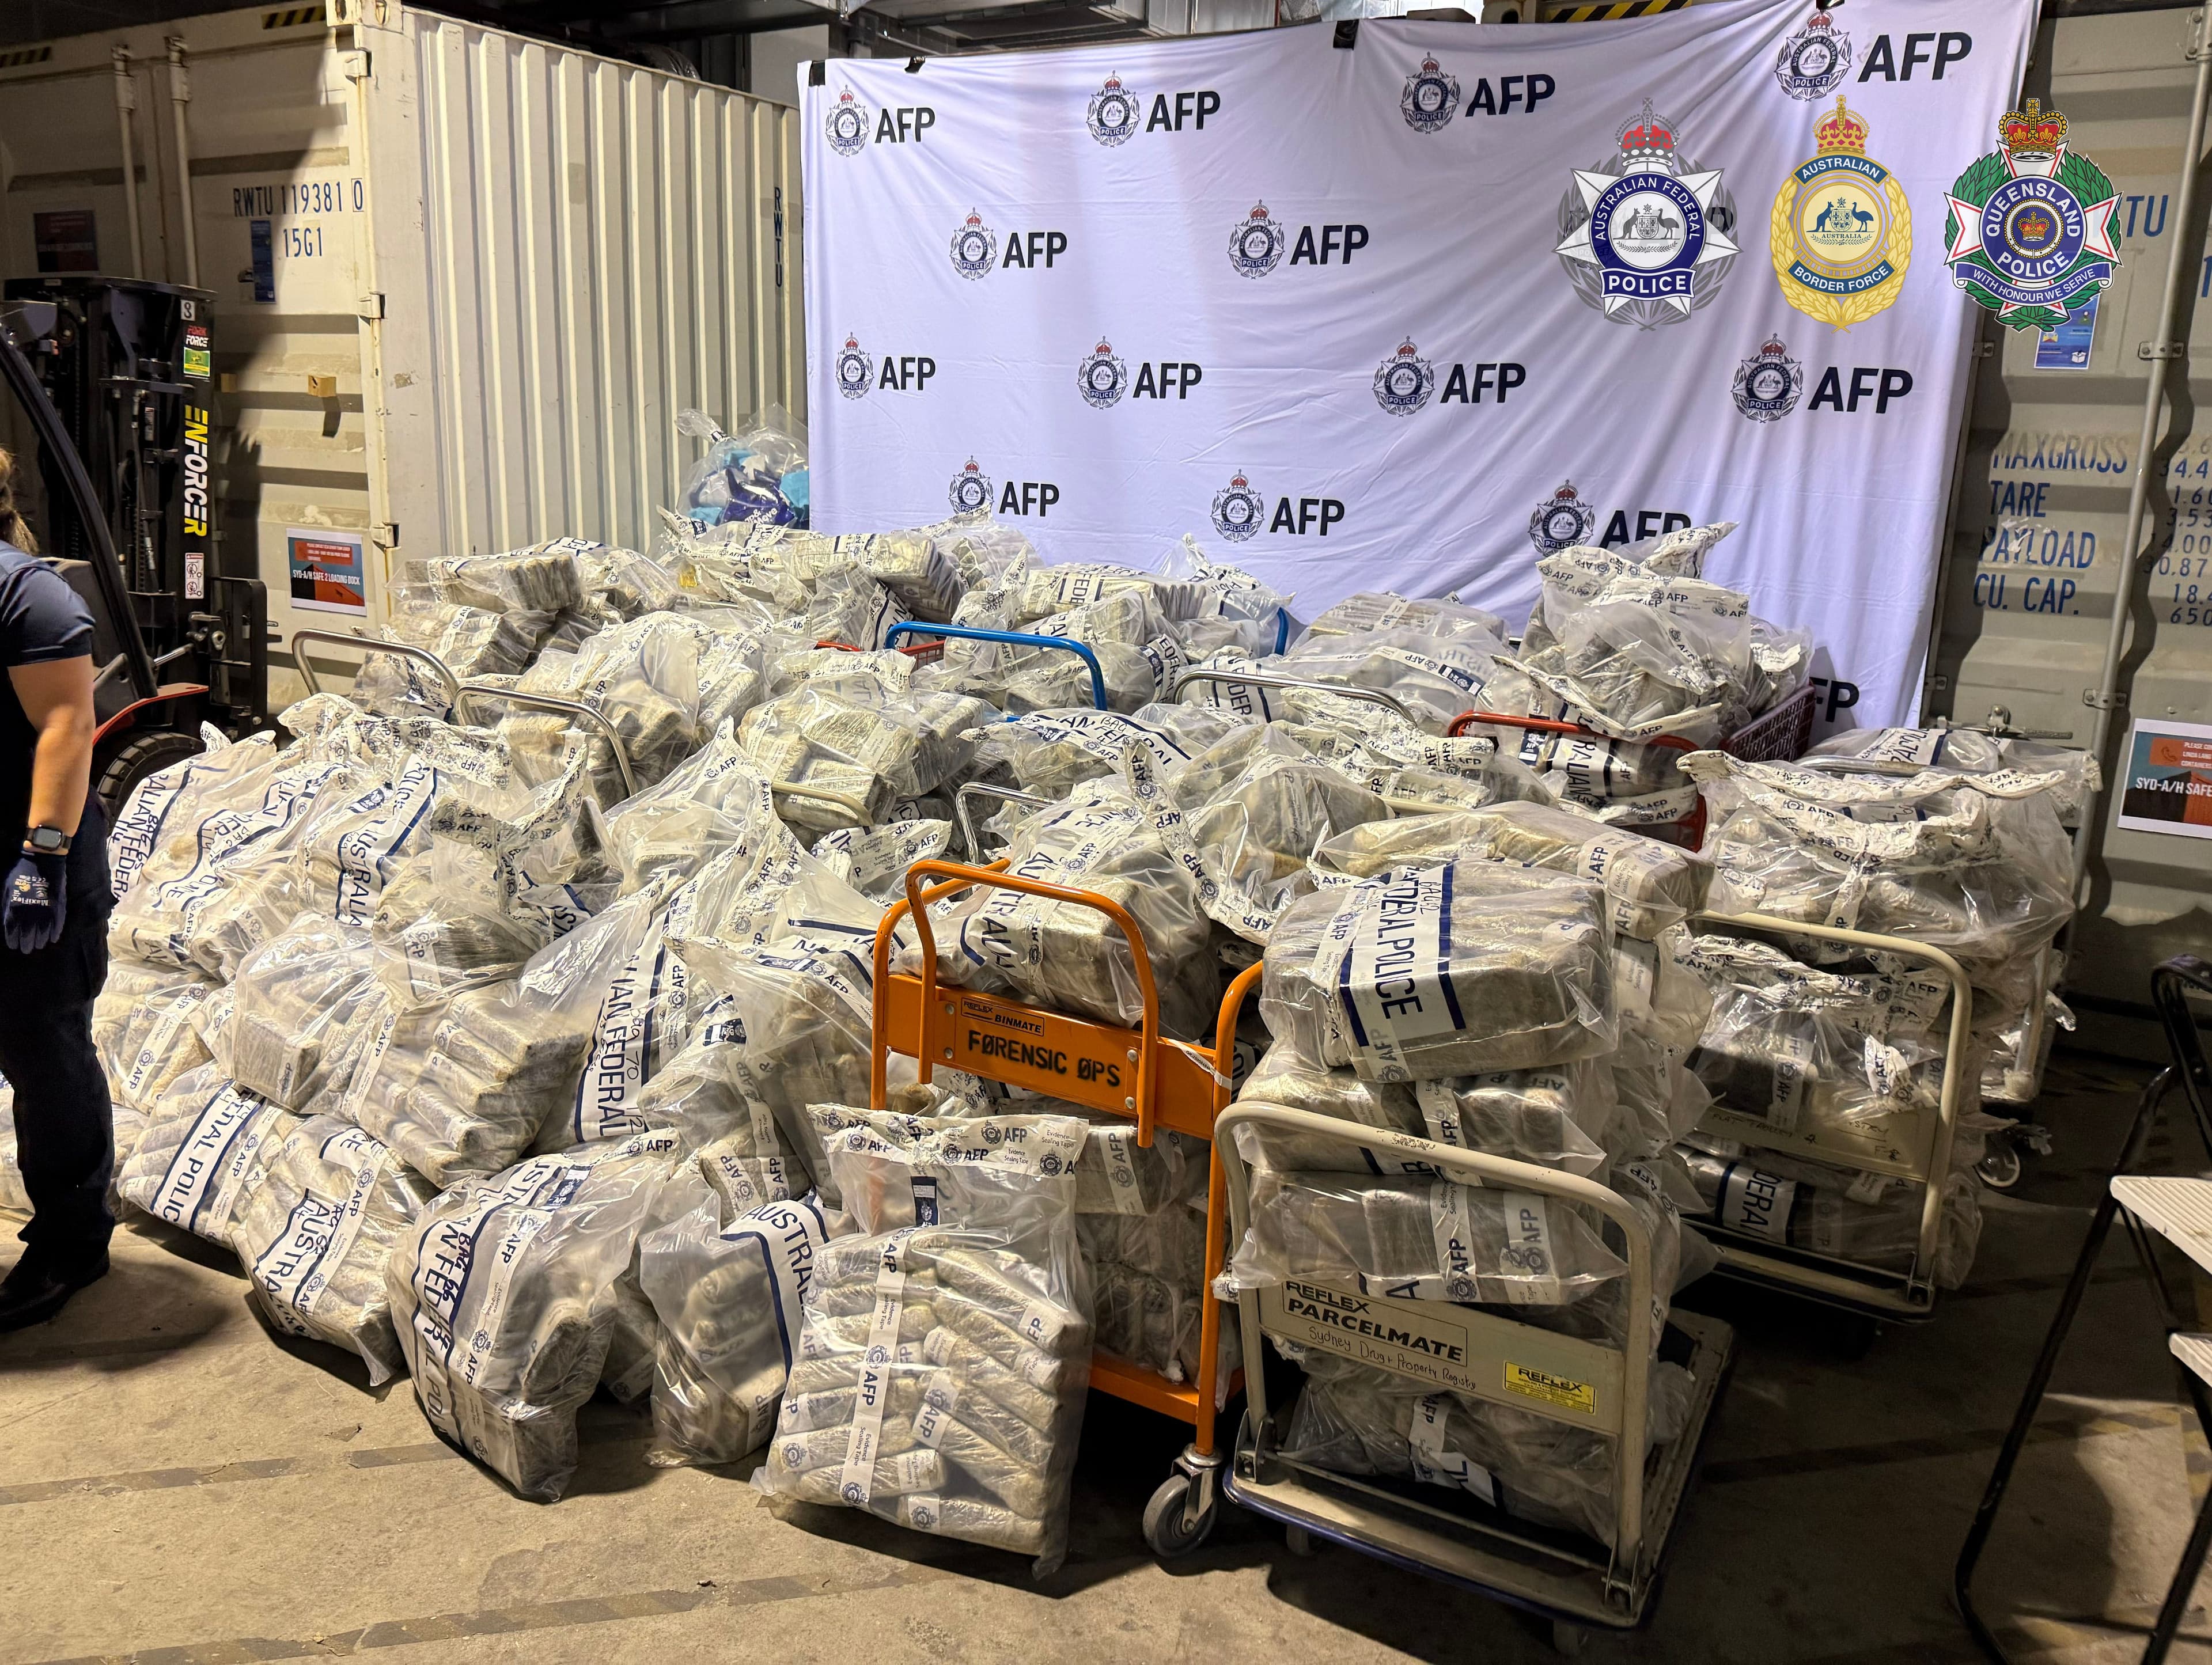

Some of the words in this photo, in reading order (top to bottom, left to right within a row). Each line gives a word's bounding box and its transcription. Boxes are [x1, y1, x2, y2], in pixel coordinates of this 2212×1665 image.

[1793, 37, 1820, 66] AUSTRALIAN
[1857, 32, 1972, 83] AFP
[1796, 78, 1827, 86] POLICE
[1465, 74, 1555, 117] AFP
[1146, 90, 1221, 132] AFP
[875, 107, 935, 143] AFP
[233, 186, 273, 217] RWTU
[281, 181, 342, 215] 119381
[353, 180, 363, 211] 0
[284, 227, 323, 257] 15G1
[774, 187, 783, 287] RWTU
[1289, 224, 1369, 266] AFP
[1002, 232, 1067, 268] AFP
[184, 302, 192, 319] 8
[185, 335, 209, 347] FORCE
[879, 356, 935, 390] AFP
[1132, 362, 1202, 400] AFP
[1385, 363, 1408, 386] AUSTRALIAN
[1440, 363, 1526, 403] AFP
[1747, 363, 1774, 388] AUSTRALIAN
[1775, 363, 1789, 390] FEDERAL
[1808, 366, 1913, 414] AFP
[1750, 401, 1781, 409] POLICE
[1994, 432, 2128, 474] MAXGROSS
[184, 404, 208, 537] ENFORCER
[999, 481, 1059, 517] AFP
[1222, 494, 1241, 515] AUSTRALIAN
[1990, 480, 2051, 518] TARE
[1270, 497, 1344, 536] AFP
[1982, 525, 2096, 569] PAYLOAD
[293, 569, 313, 580] SYD-A/H
[313, 571, 325, 582] SAFE
[325, 572, 329, 582] 2
[329, 574, 347, 584] LOADING
[347, 576, 361, 586] DOCK
[1552, 570, 1574, 581] AFP
[1615, 557, 1623, 576] AFP
[1666, 592, 1688, 602] AFP
[1974, 574, 2008, 610] CU.
[2024, 579, 2080, 615] CAP.
[1405, 655, 1426, 665] AFP
[699, 681, 711, 693] AFP
[1100, 717, 1128, 733] BAG
[1639, 726, 1663, 736] AFP
[719, 757, 737, 772] AFP
[1097, 749, 1118, 761] AFP
[1131, 754, 1147, 781] AFP
[2136, 777, 2184, 794] SYD-A/H
[2186, 783, 2212, 798] SAFE
[762, 791, 770, 811] AFP
[1156, 811, 1181, 829] AFP
[1656, 808, 1678, 821] AFP
[921, 833, 938, 848] AFP
[1079, 843, 1094, 859] AFP
[758, 857, 775, 883] AFP
[1184, 854, 1206, 879] AFP
[1588, 846, 1608, 876] AFP
[348, 830, 378, 927] USTRALIA
[1323, 876, 1352, 885] AFP
[1613, 863, 1628, 888] Evidence
[1243, 915, 1272, 930] AFP
[1615, 900, 1635, 931] AFP
[1330, 924, 1350, 940] AFP
[672, 965, 684, 988] AFP
[825, 974, 849, 993] AFP
[1374, 937, 1423, 1019] POLICE
[1907, 982, 1937, 997] AFP
[963, 1002, 994, 1014] REFLEX
[994, 1014, 1043, 1034] BINMATE
[376, 1031, 386, 1057] AFP
[130, 1066, 142, 1090] AFP
[599, 1025, 627, 1137] FEDERAL
[646, 1139, 673, 1153] AFP
[1004, 1127, 1028, 1144] AFP
[1041, 1137, 1059, 1146] Sealing
[1059, 1139, 1075, 1149] Tape
[1047, 1129, 1069, 1140] Evidence
[963, 1149, 989, 1161] AFP
[1005, 1155, 1018, 1163] Sealing
[1008, 1148, 1025, 1156] Evidence
[1109, 1132, 1127, 1163] AFP
[233, 1152, 247, 1177] AFP
[720, 1155, 744, 1179] AFP
[770, 1158, 784, 1184] AFP
[1629, 1167, 1658, 1192] AFP
[351, 1189, 363, 1217] AFP
[1521, 1207, 1541, 1244] AFP
[503, 1233, 522, 1264] AFP
[884, 1243, 897, 1274] AFP
[1450, 1238, 1469, 1276] AFP
[881, 1294, 891, 1315] Sealing
[1286, 1280, 1370, 1314] REFLEX
[879, 1315, 887, 1330] Tape
[887, 1298, 896, 1326] Evidence
[1287, 1299, 1464, 1363] PARCELMATE
[466, 1352, 478, 1386] AFP
[1308, 1326, 1351, 1352] Sydney
[1359, 1341, 1385, 1363] Drug
[1397, 1353, 1438, 1379] Property
[1442, 1367, 1477, 1390] Registry
[862, 1370, 879, 1406] AFP
[1517, 1366, 1583, 1394] REFLEX
[923, 1406, 941, 1439] AFP
[856, 1427, 868, 1452] Sealing
[861, 1433, 872, 1462] Evidence
[853, 1452, 862, 1467] Tape
